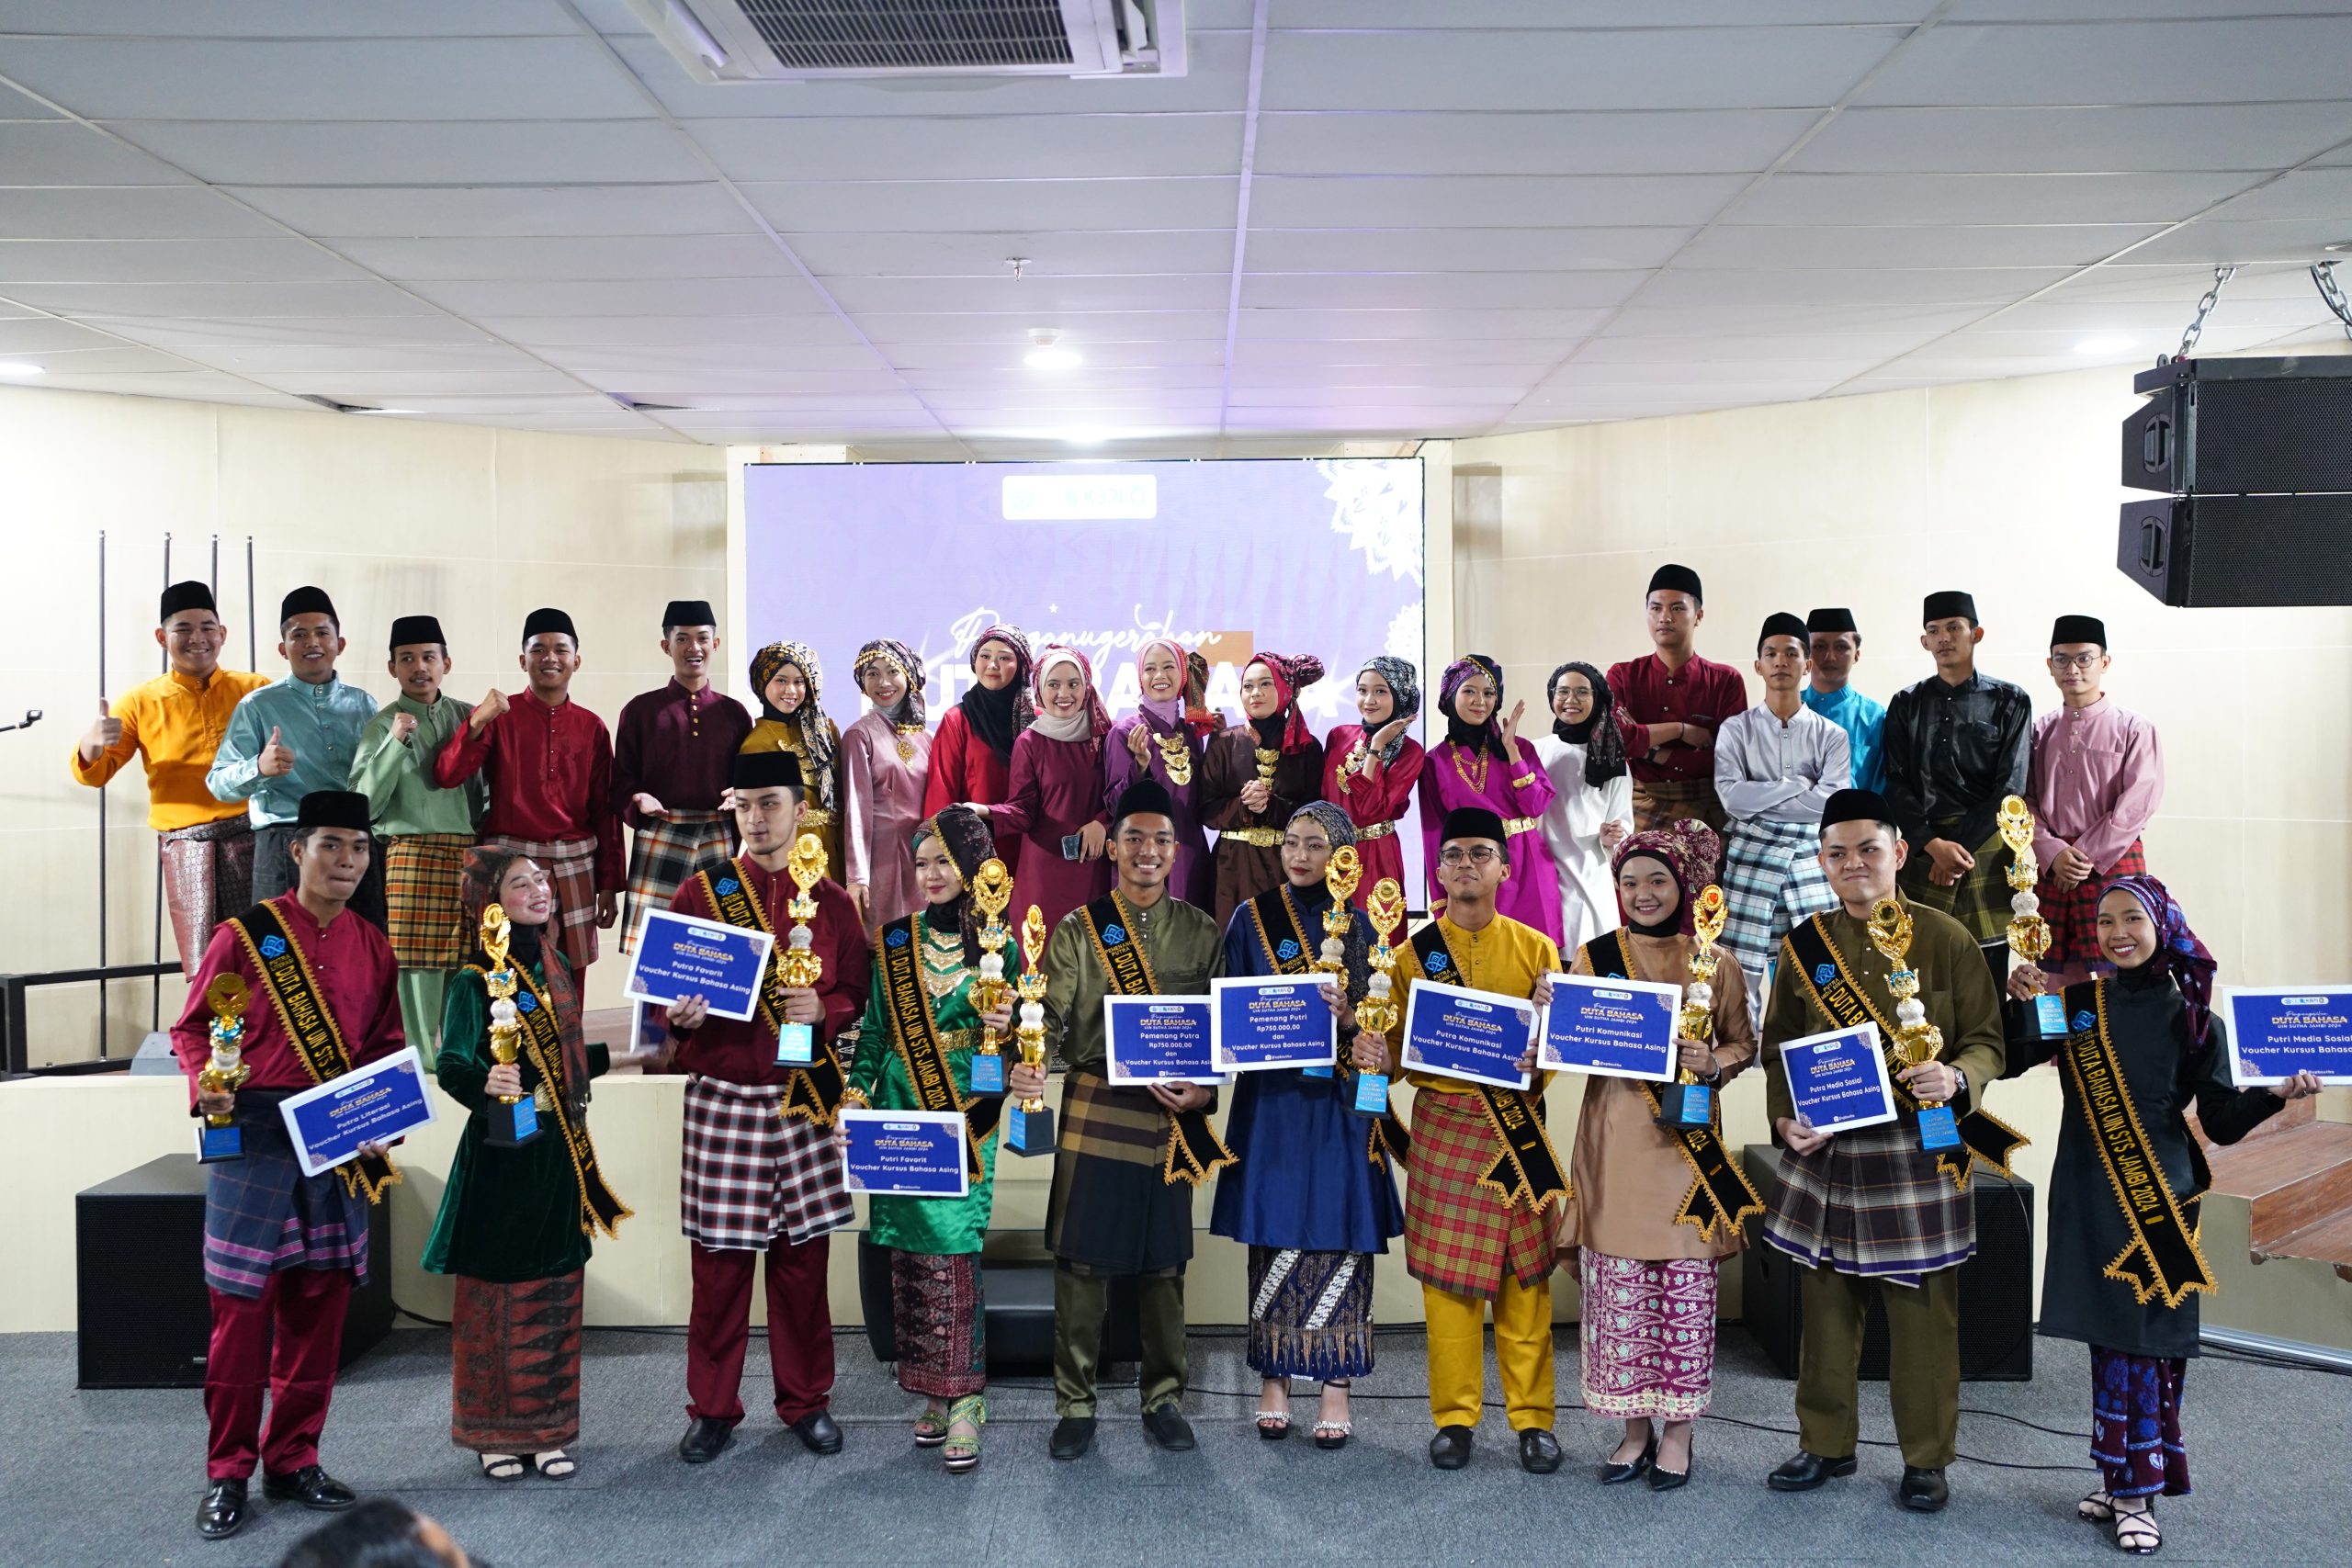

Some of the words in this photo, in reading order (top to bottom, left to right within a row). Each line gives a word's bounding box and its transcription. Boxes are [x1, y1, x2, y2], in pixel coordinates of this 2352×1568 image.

[950, 603, 1222, 668] Pganugerahan
[727, 900, 752, 927] DUTA
[673, 942, 697, 955] DUTA
[698, 948, 734, 962] BAHASA
[1112, 947, 1130, 956] PUTRA
[275, 964, 302, 995] DUTA
[639, 964, 671, 976] Voucher
[673, 973, 698, 983] Kursus
[700, 977, 728, 988] Bahasa
[729, 984, 751, 995] Asing
[672, 961, 694, 971] Putra
[695, 966, 723, 977] Favorit
[891, 956, 910, 984] DUTA
[1114, 953, 1139, 982] DUTA
[287, 991, 316, 1033] BAHASA
[897, 982, 918, 1025] BAHASA
[1581, 1008, 1605, 1016] DUTA
[1607, 1010, 1644, 1021] BAHASA
[1829, 987, 1858, 1020] DUTA
[535, 1016, 553, 1046] DUTA
[1443, 1014, 1465, 1025] DUTA
[1467, 1019, 1502, 1032] BAHASA
[1576, 1025, 1595, 1033] Putri
[1597, 1028, 1643, 1038] Komunikasi
[910, 1037, 931, 1058] STS
[1413, 1035, 1443, 1046] Voucher
[1445, 1042, 1470, 1053] Kursus
[1472, 1047, 1499, 1058] Bahasa
[1436, 1031, 1457, 1040] Putra
[1459, 1035, 1501, 1048] Komunikasi
[1550, 1033, 1582, 1042] Voucher
[1613, 1041, 1642, 1049] Bahasa
[1645, 1044, 1666, 1053] Asing
[1811, 1065, 1828, 1074] DUTA
[1828, 1059, 1855, 1070] BAHASA
[2077, 1039, 2101, 1072] DUTA
[917, 1056, 941, 1089] JAMBI
[1810, 1085, 1826, 1093] Putra
[1826, 1081, 1844, 1089] Media
[1845, 1077, 1862, 1086] Sosial
[923, 1083, 948, 1111] 2024
[1798, 1097, 1820, 1106] Voucher
[1822, 1093, 1840, 1101] Kursus
[1842, 1089, 1862, 1098] Bahasa
[2086, 1068, 2117, 1116] BAHASA
[308, 1133, 341, 1150] Voucher
[343, 1122, 369, 1136] Kursus
[371, 1108, 400, 1122] Bahasa
[401, 1098, 423, 1111] Asing
[336, 1117, 359, 1130] Putra
[361, 1103, 390, 1119] Literasi
[1501, 1106, 1526, 1130] 2024
[2109, 1130, 2136, 1154] STS
[2118, 1155, 2149, 1189] JAMBI
[2131, 1185, 2161, 1213] 2024
